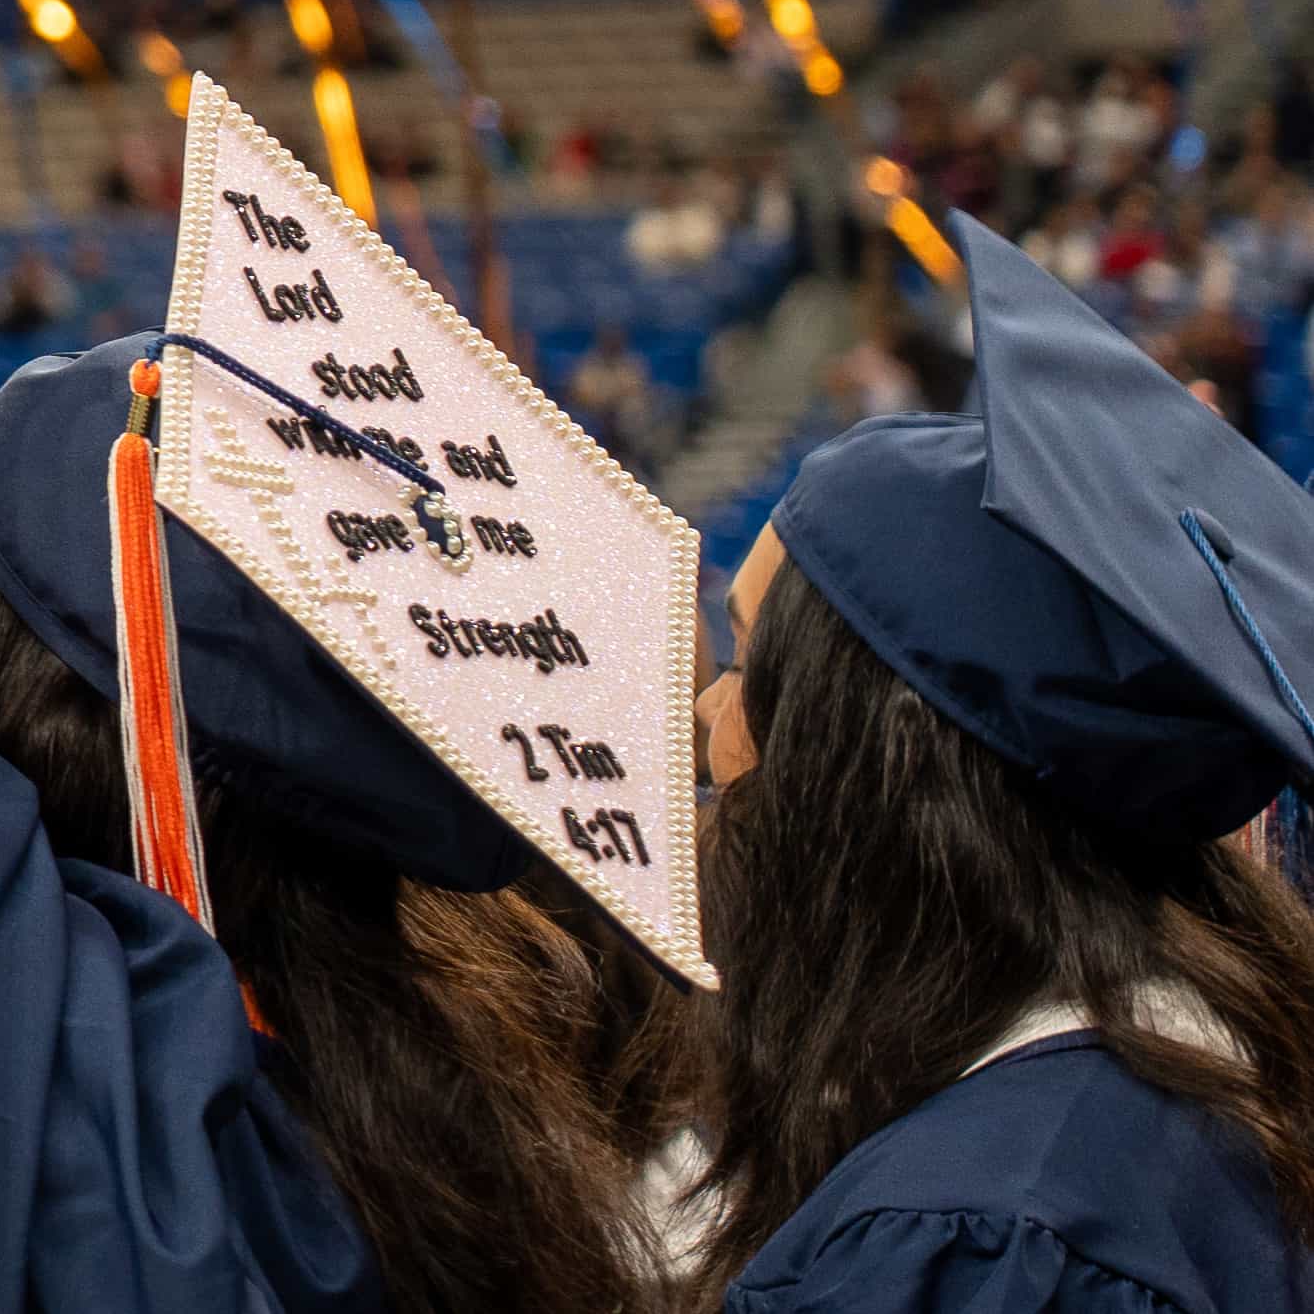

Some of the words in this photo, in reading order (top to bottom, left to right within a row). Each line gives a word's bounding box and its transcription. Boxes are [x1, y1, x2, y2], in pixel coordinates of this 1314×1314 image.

[223, 190, 310, 253] The
[244, 267, 343, 323] Lord
[312, 348, 424, 402] stood
[441, 435, 517, 487] and
[327, 511, 414, 563] gave
[471, 515, 538, 558] me
[408, 603, 589, 675] Strength
[502, 724, 549, 781] 2
[538, 724, 626, 780] Tim
[561, 806, 651, 866] 4:17
